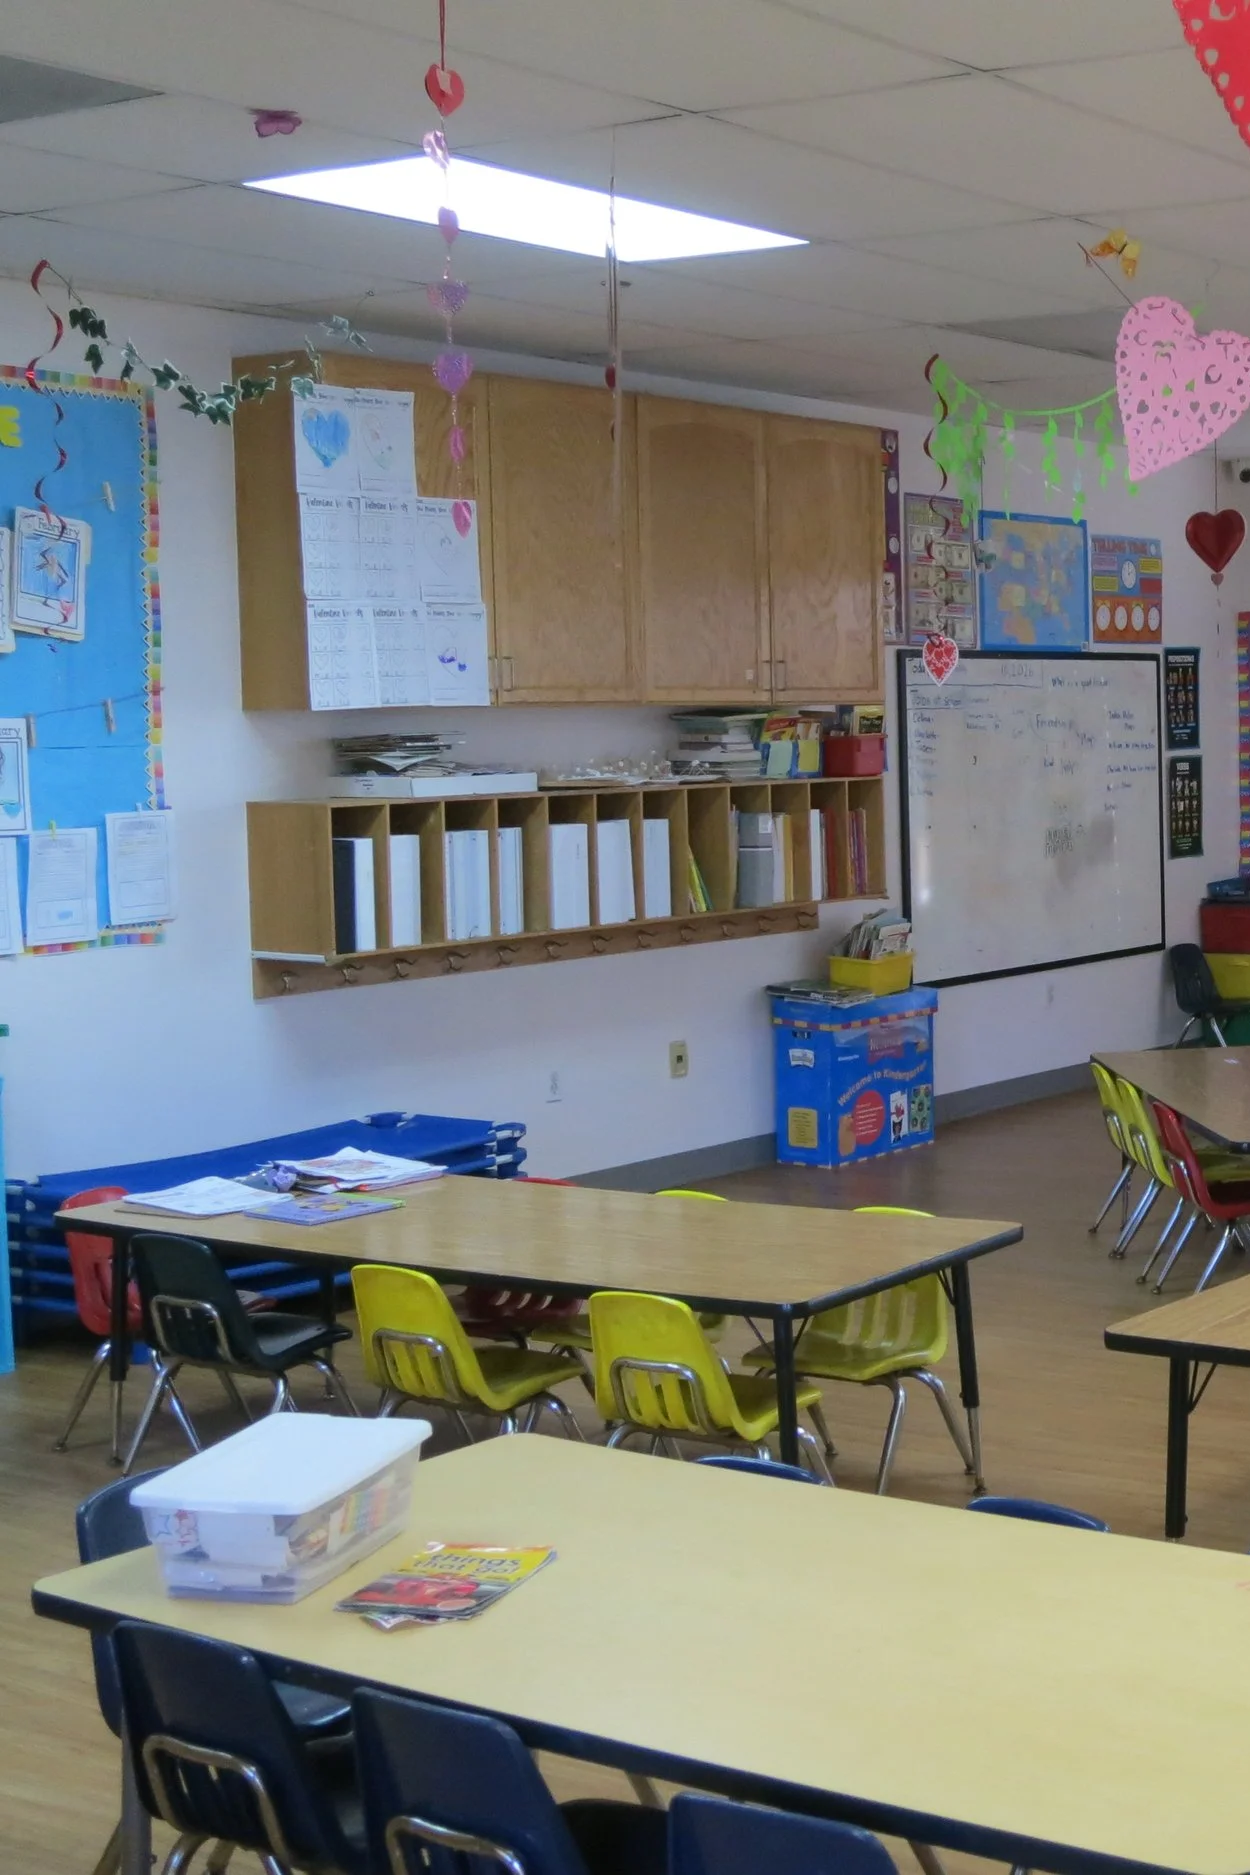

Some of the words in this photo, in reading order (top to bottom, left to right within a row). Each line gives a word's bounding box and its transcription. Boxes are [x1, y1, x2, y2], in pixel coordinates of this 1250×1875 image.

[38, 517, 81, 538] Febrary
[838, 1073, 873, 1107] Welcome
[873, 1071, 882, 1081] to
[413, 1559, 466, 1571] that
[474, 1562, 519, 1574] go!
[431, 1553, 521, 1568] things
